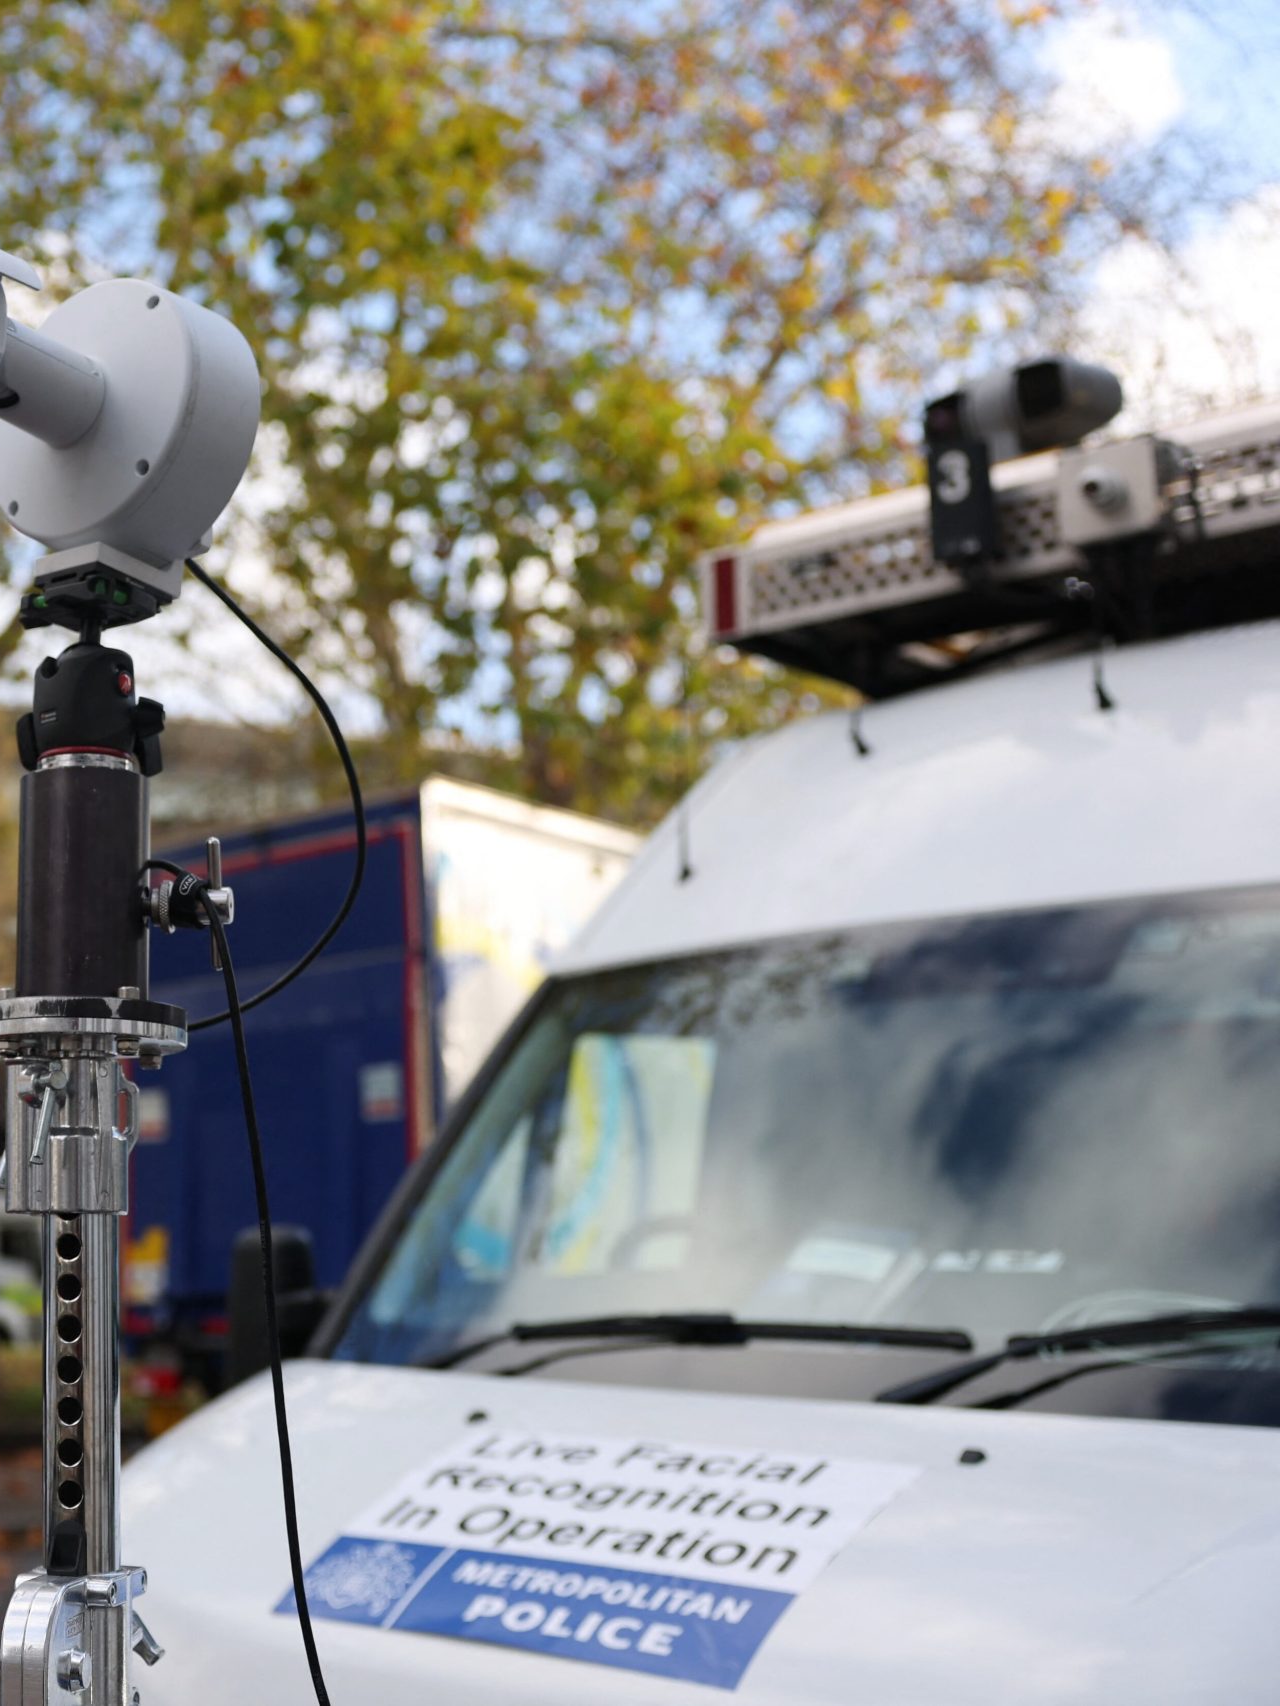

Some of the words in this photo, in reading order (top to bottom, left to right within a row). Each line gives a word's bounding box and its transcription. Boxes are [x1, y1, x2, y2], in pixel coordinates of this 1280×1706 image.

[937, 450, 971, 504] 3
[471, 1434, 598, 1464] Live
[615, 1441, 828, 1486] Facial
[426, 1465, 830, 1527] Recognition
[379, 1497, 438, 1530] In
[458, 1504, 799, 1573] Operation
[452, 1559, 753, 1624] METROPOLITAN
[462, 1594, 683, 1657] POLICE
